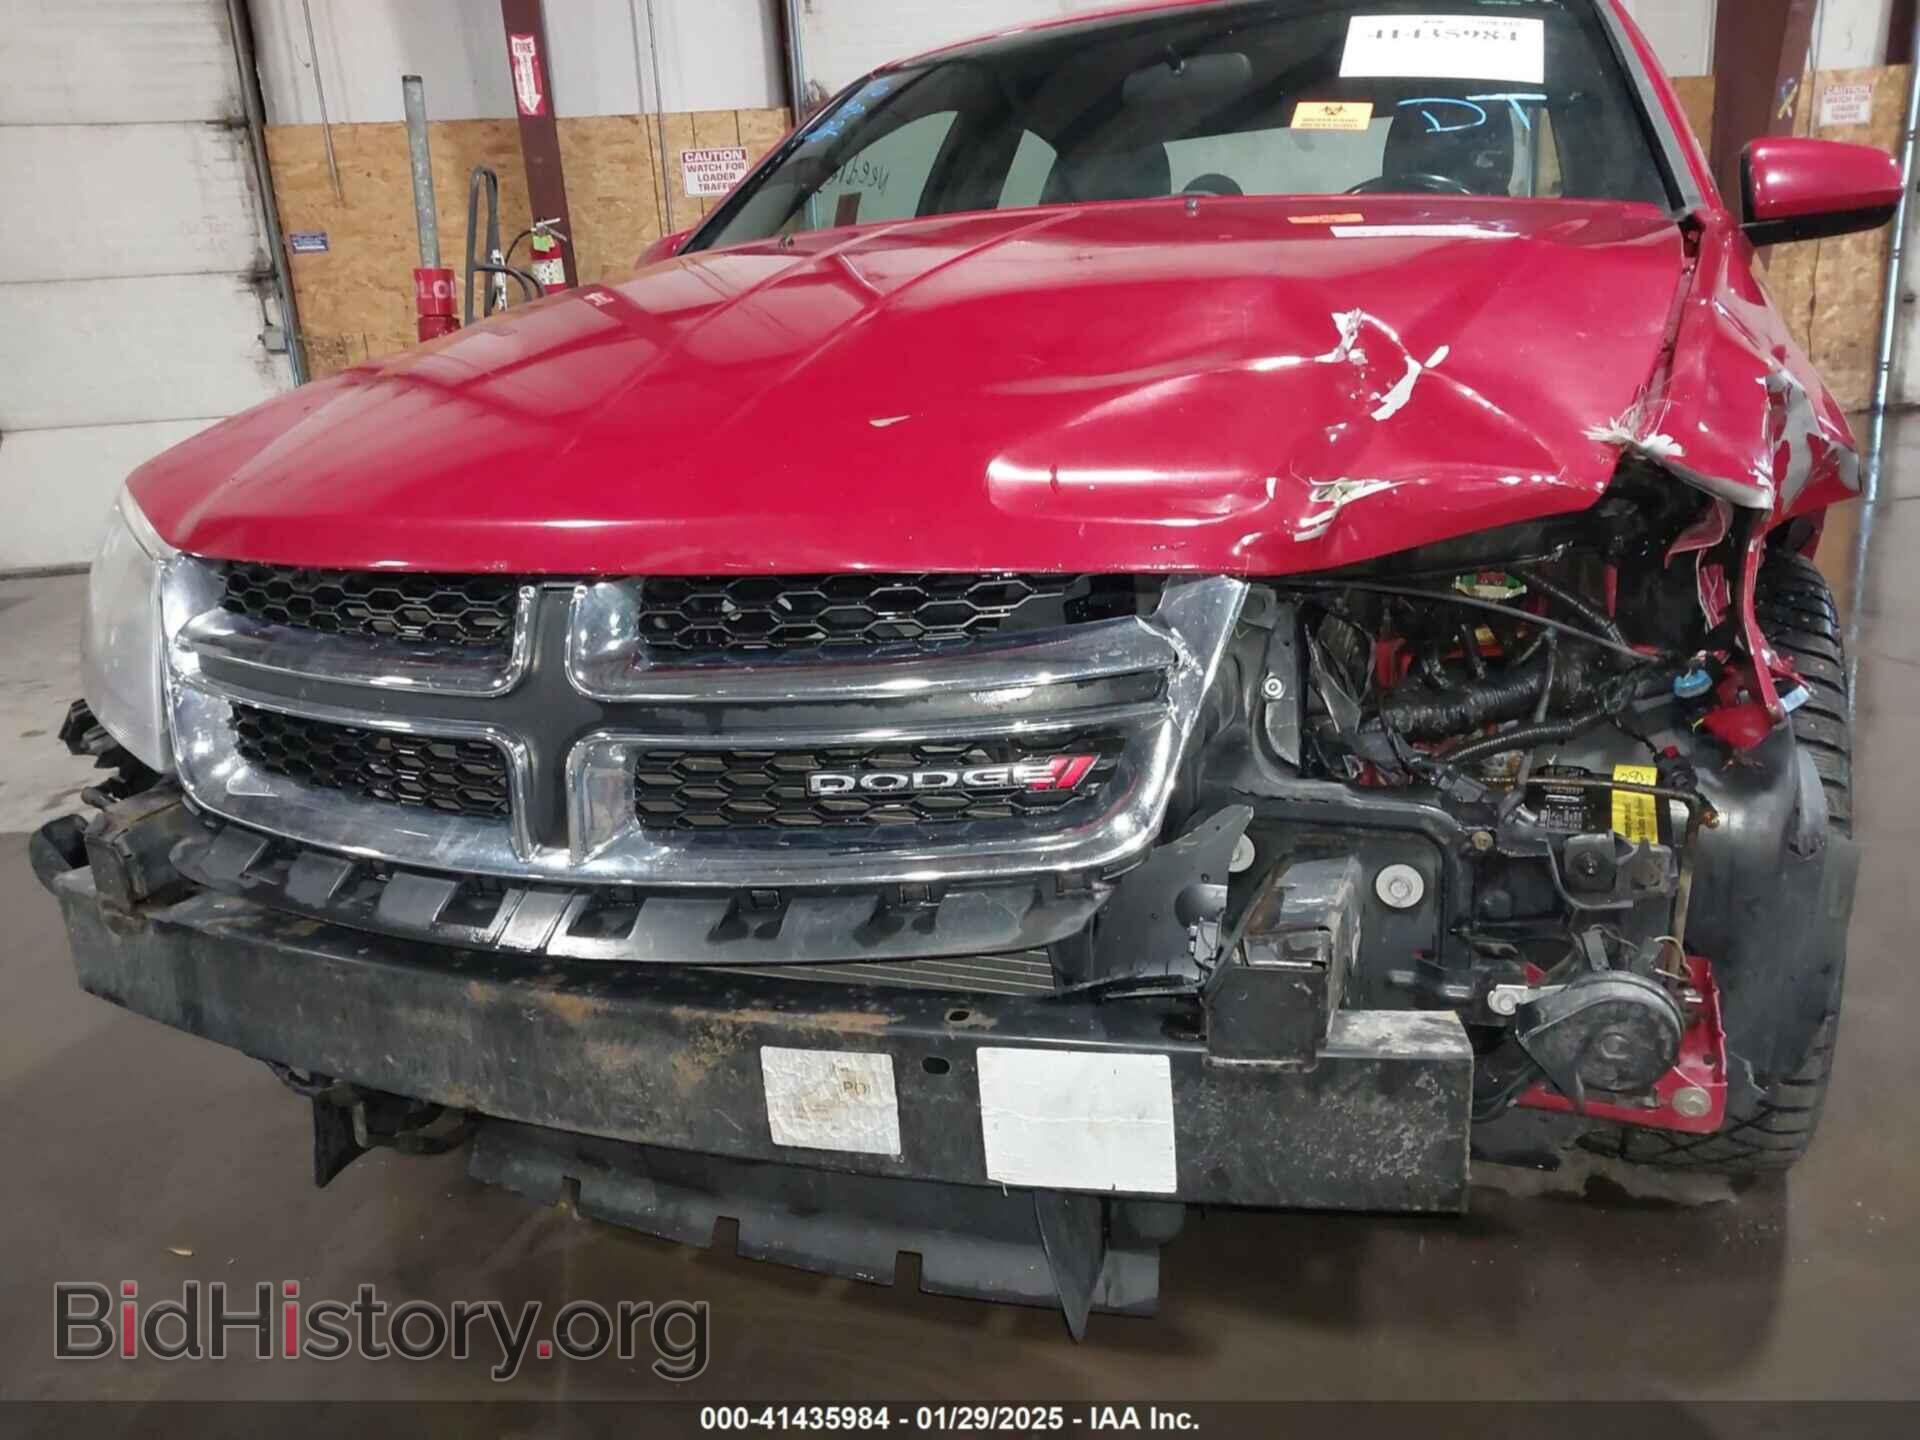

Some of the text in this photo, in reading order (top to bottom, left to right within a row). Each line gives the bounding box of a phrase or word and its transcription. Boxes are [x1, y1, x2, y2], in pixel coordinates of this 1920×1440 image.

[684, 150, 743, 162] CAUTION
[686, 162, 745, 173] WATCH FOR
[697, 172, 736, 182] LOADER
[810, 760, 1057, 793] DODGE
